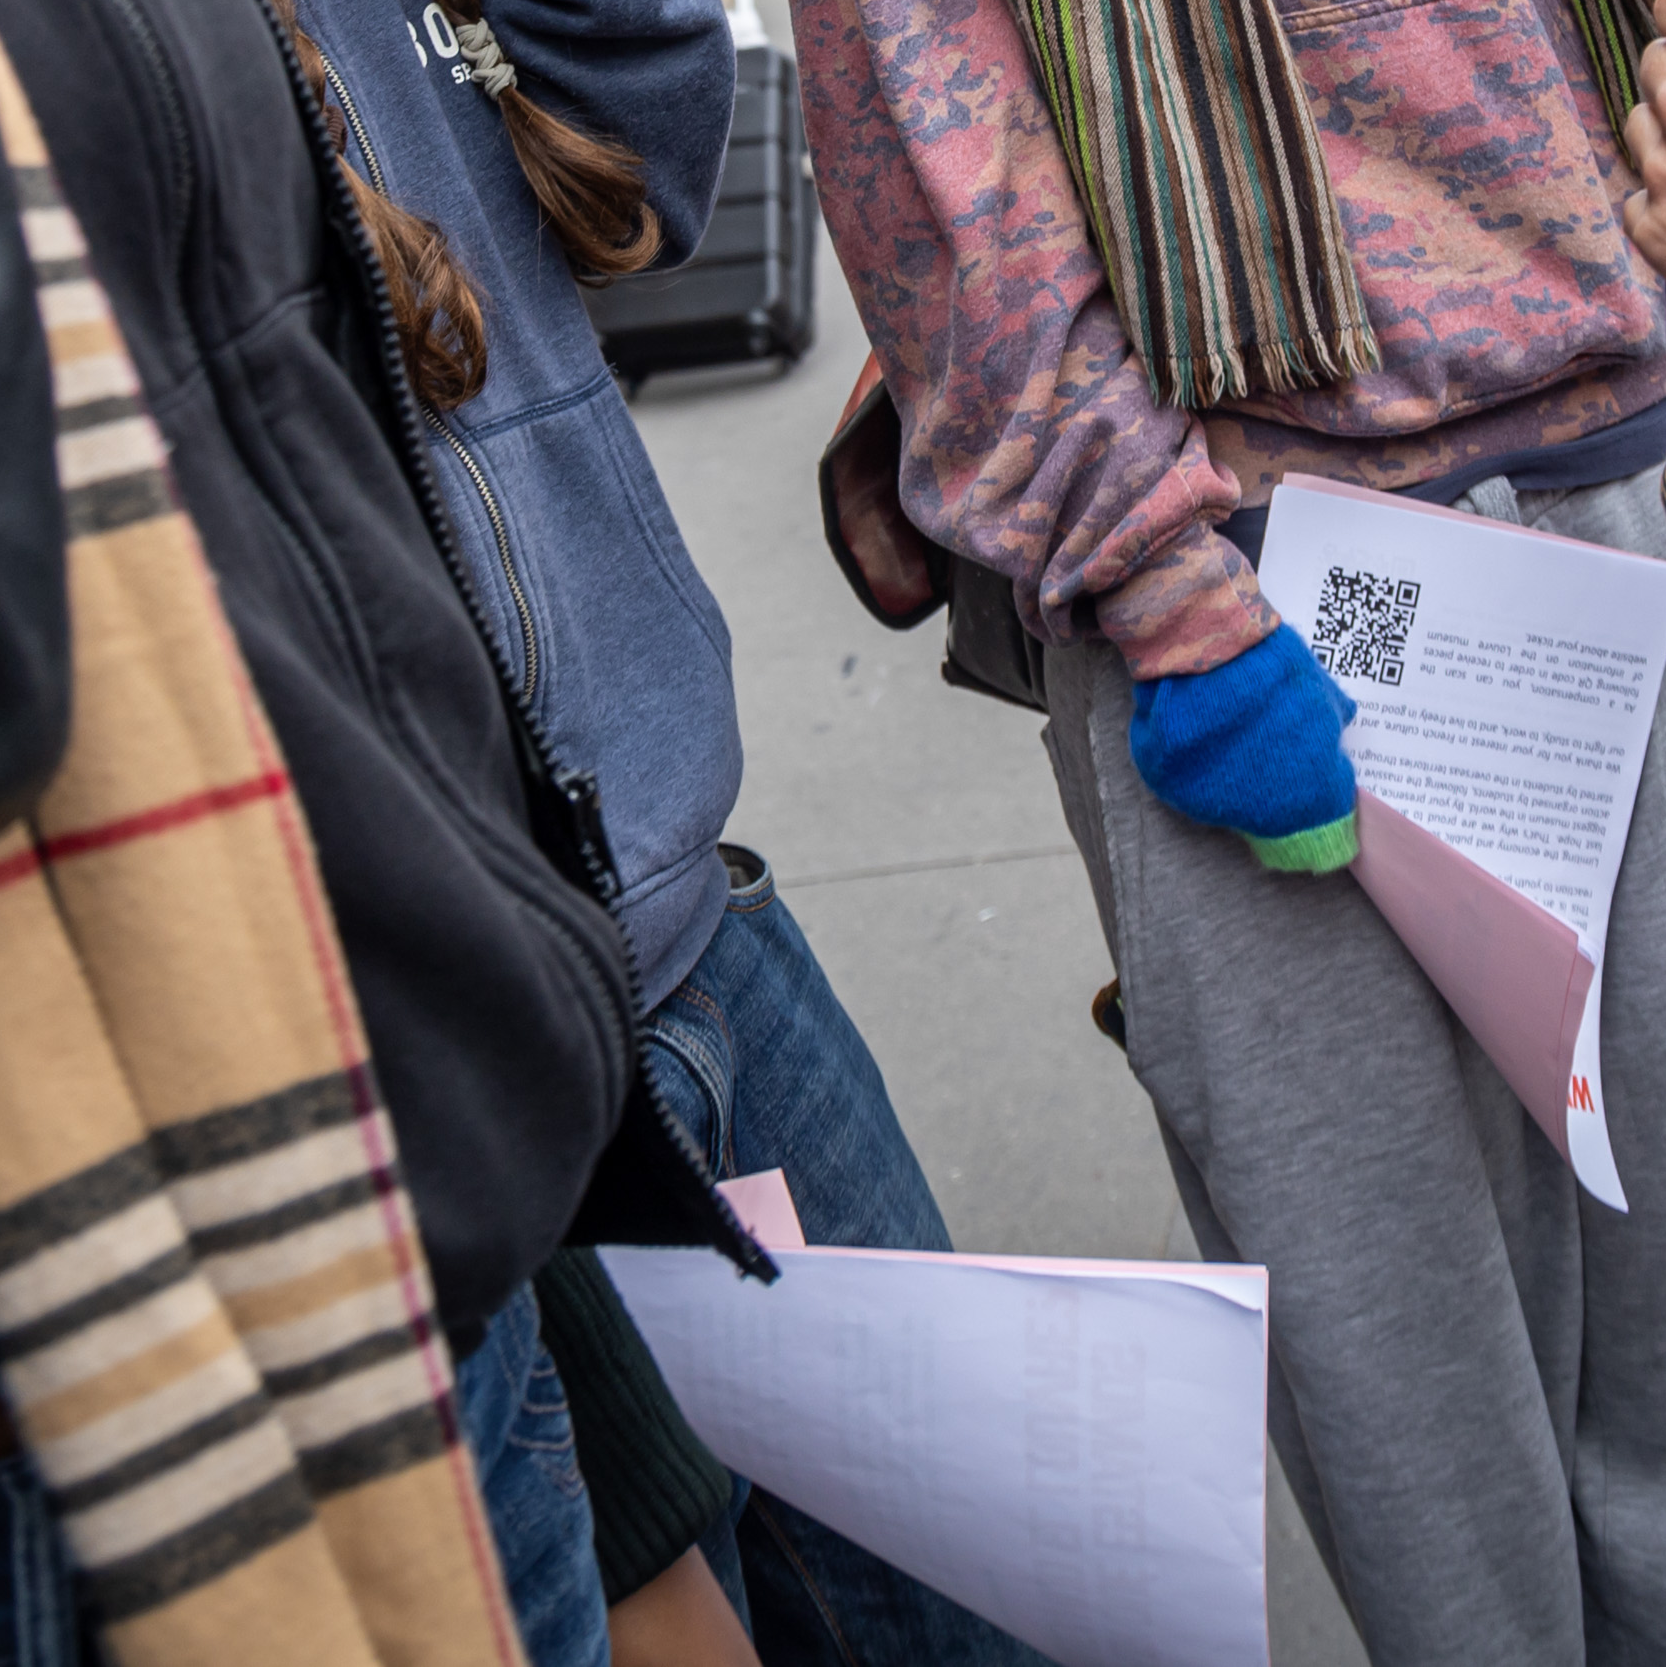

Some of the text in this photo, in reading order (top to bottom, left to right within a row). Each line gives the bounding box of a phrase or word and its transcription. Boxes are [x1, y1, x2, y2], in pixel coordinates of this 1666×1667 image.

[1554, 640, 1580, 652] your
[1579, 644, 1610, 659] about
[1426, 631, 1644, 682] of information on the Louvre museum
[1610, 650, 1648, 665] website
[1419, 662, 1436, 675] the
[1423, 646, 1640, 700] following QR code in order to receive pieces
[1444, 668, 1468, 680] scan
[1475, 674, 1494, 685] can
[1501, 678, 1522, 690] you
[1380, 704, 1408, 716] good
[1608, 700, 1616, 708] a
[1623, 702, 1637, 714] As
[1407, 708, 1418, 720] in
[1418, 708, 1448, 726] freely
[1359, 717, 1381, 728] and
[1448, 716, 1466, 730] live
[1466, 719, 1478, 730] to
[1478, 722, 1499, 733] and
[1422, 728, 1456, 744] French
[1458, 735, 1469, 746] in
[1528, 730, 1540, 742] to
[1470, 737, 1509, 753] interest
[1510, 744, 1535, 756] your
[1570, 738, 1583, 750] to
[1583, 740, 1606, 756] fight
[1607, 746, 1626, 756] our
[1356, 747, 1398, 766] through
[1536, 750, 1552, 762] for
[1553, 752, 1574, 763] you
[1575, 756, 1603, 770] thank
[1398, 757, 1448, 775] territories
[1604, 762, 1621, 774] We
[1363, 767, 1404, 782] massive
[1448, 766, 1492, 782] overseas
[1492, 774, 1510, 786] the
[1405, 775, 1423, 788] the
[1424, 776, 1469, 797] following
[1510, 777, 1522, 788] in
[1522, 779, 1565, 795] students
[1564, 784, 1578, 800] by
[1578, 790, 1614, 804] started
[1427, 796, 1452, 808] your
[1452, 797, 1466, 812] By
[1516, 792, 1530, 808] by
[1530, 798, 1579, 814] organised
[1410, 810, 1424, 824] to
[1426, 812, 1458, 826] proud
[1498, 808, 1516, 820] the
[1516, 812, 1527, 823] in
[1580, 806, 1611, 819] action
[1460, 819, 1478, 829] are
[1480, 822, 1496, 832] we
[1528, 814, 1571, 829] museum
[1498, 822, 1519, 837] why
[1522, 828, 1550, 844] That's
[1571, 821, 1607, 837] biggest
[1442, 832, 1475, 848] public
[1475, 838, 1496, 849] and
[1496, 838, 1541, 856] economy
[1585, 839, 1604, 853] last
[1542, 849, 1560, 861] the
[1561, 850, 1601, 868] Limiting
[1511, 875, 1543, 891] youth
[1544, 882, 1554, 893] to
[1554, 884, 1594, 898] reaction
